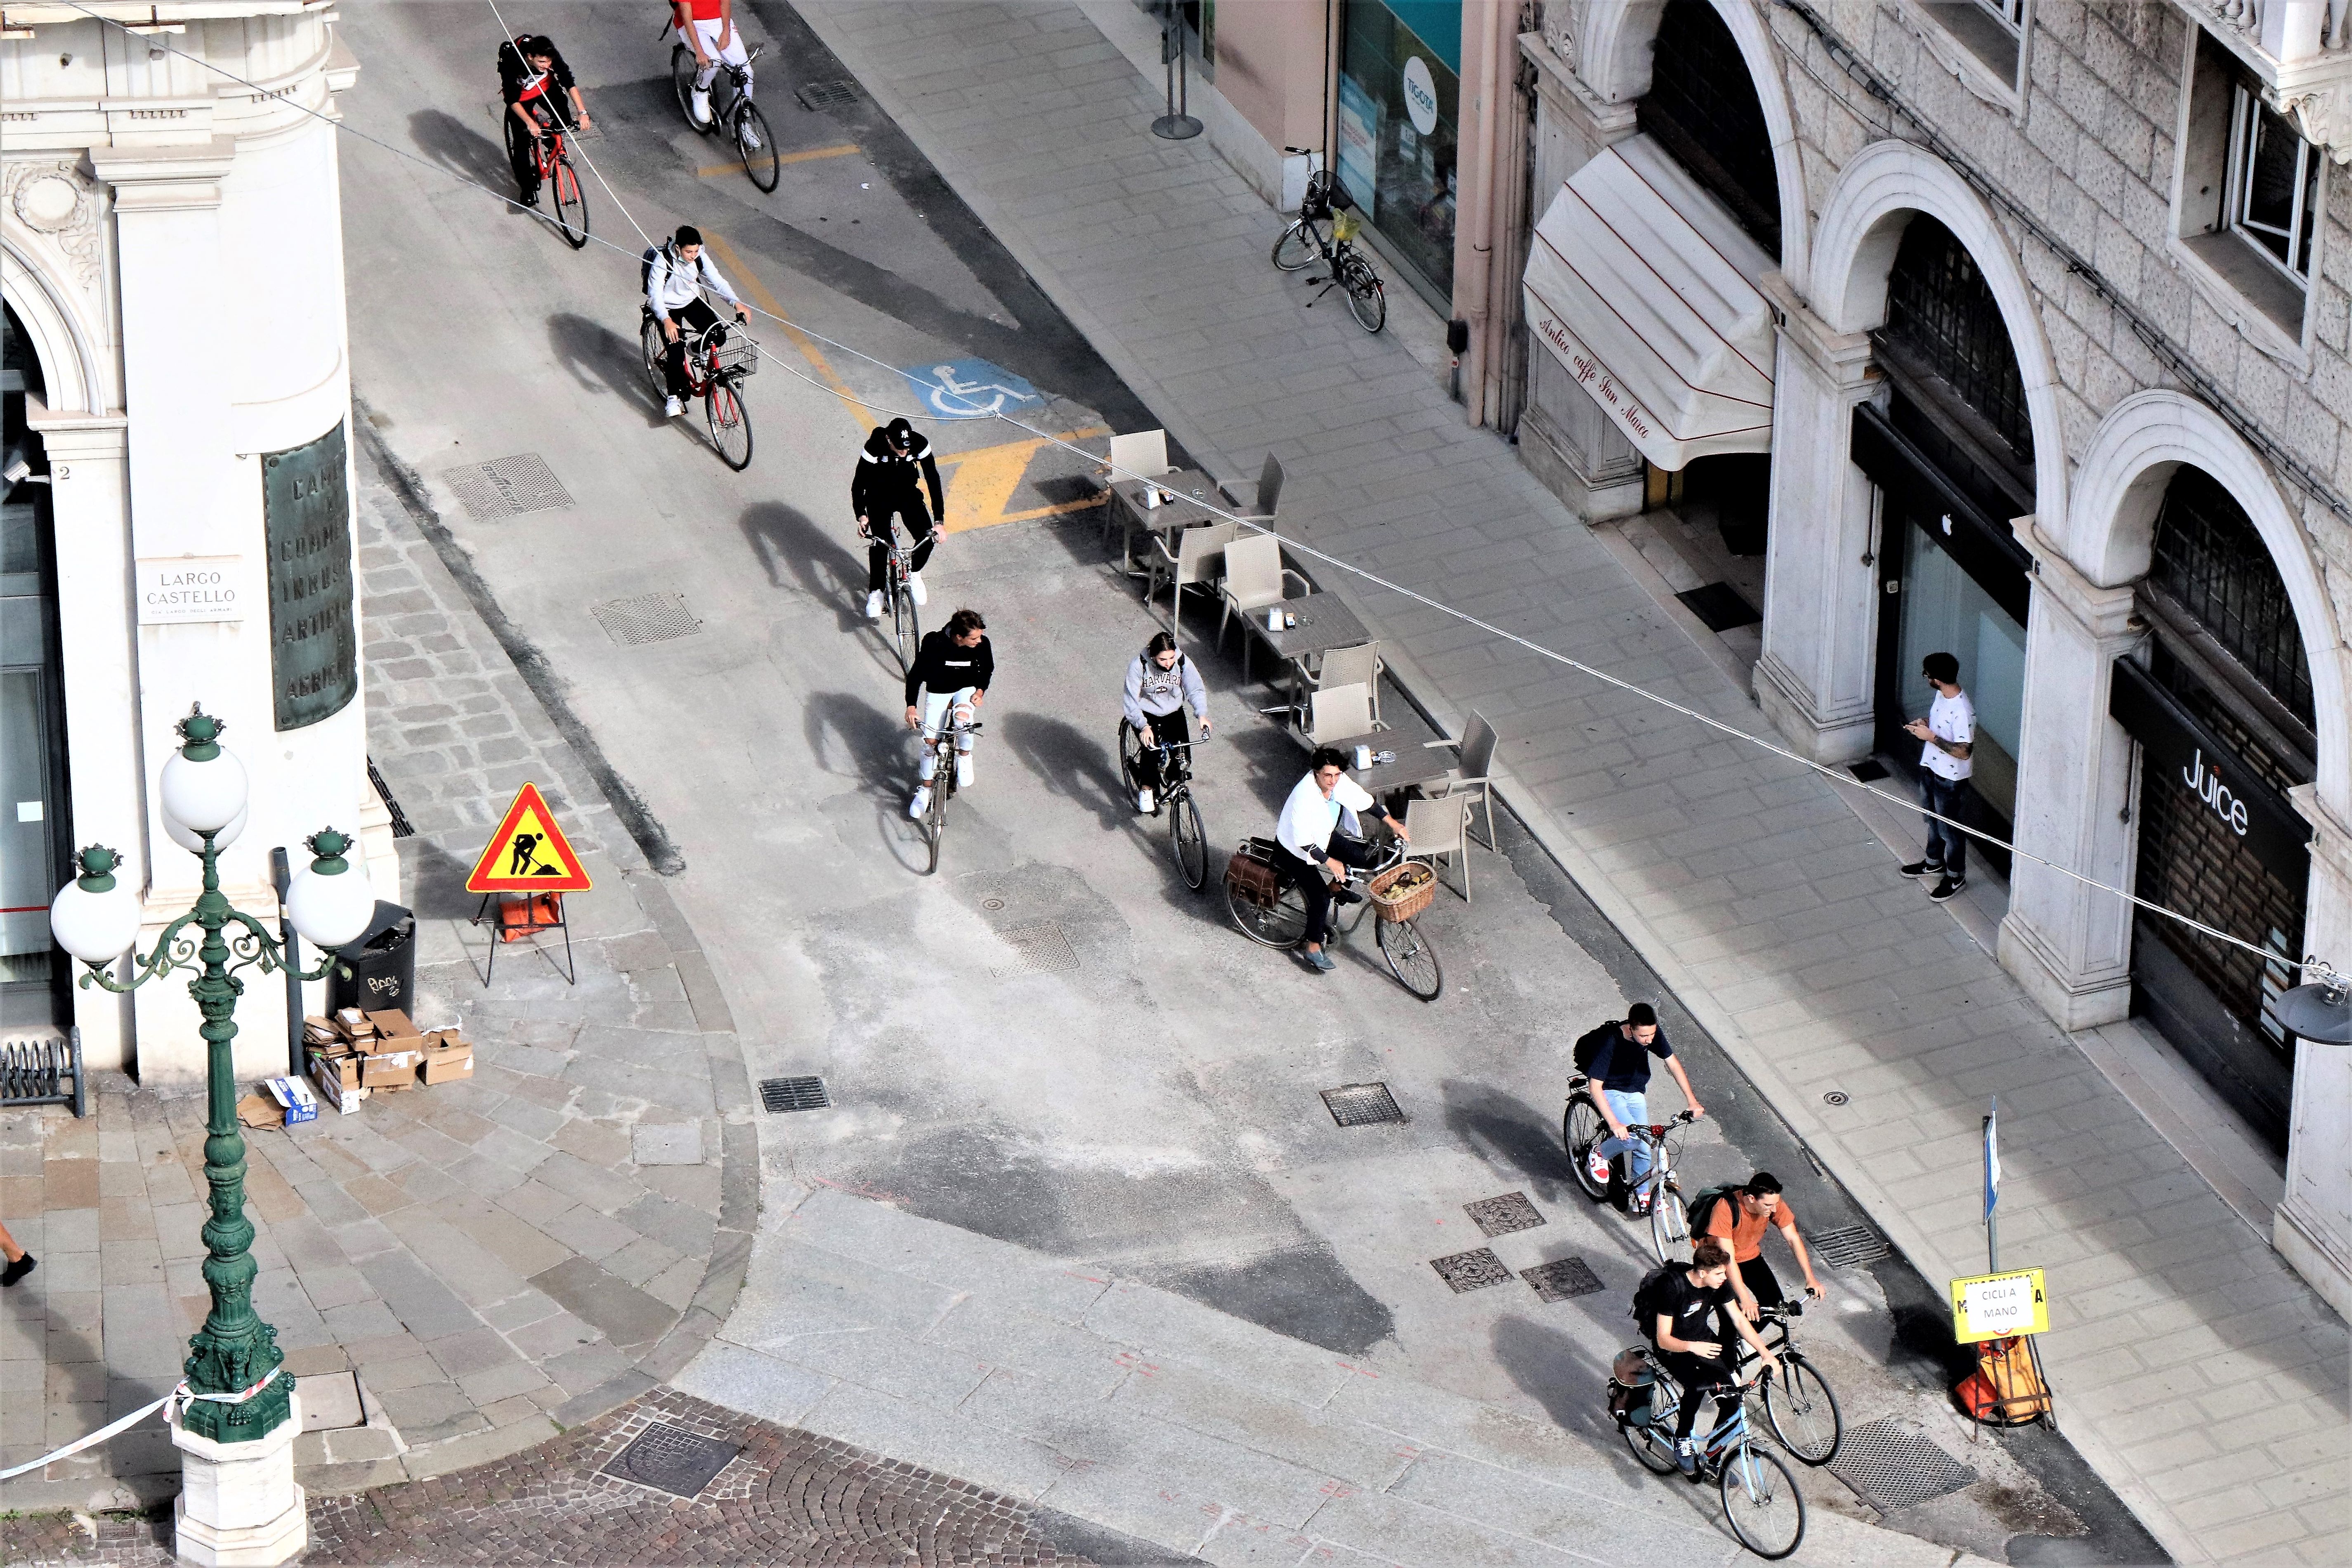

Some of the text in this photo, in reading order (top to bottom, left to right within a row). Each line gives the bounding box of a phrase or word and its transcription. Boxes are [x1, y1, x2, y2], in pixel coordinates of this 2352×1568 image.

[1540, 319, 1570, 354] Antico
[1599, 376, 1618, 405] San
[1620, 404, 1649, 439] Marco
[59, 467, 70, 479] 2
[161, 572, 221, 586] LARGO
[147, 590, 235, 605] CASTELLO
[2183, 749, 2248, 836] Juice
[1982, 1288, 2016, 1300] CICLI A
[1984, 1306, 2017, 1318] MANO
